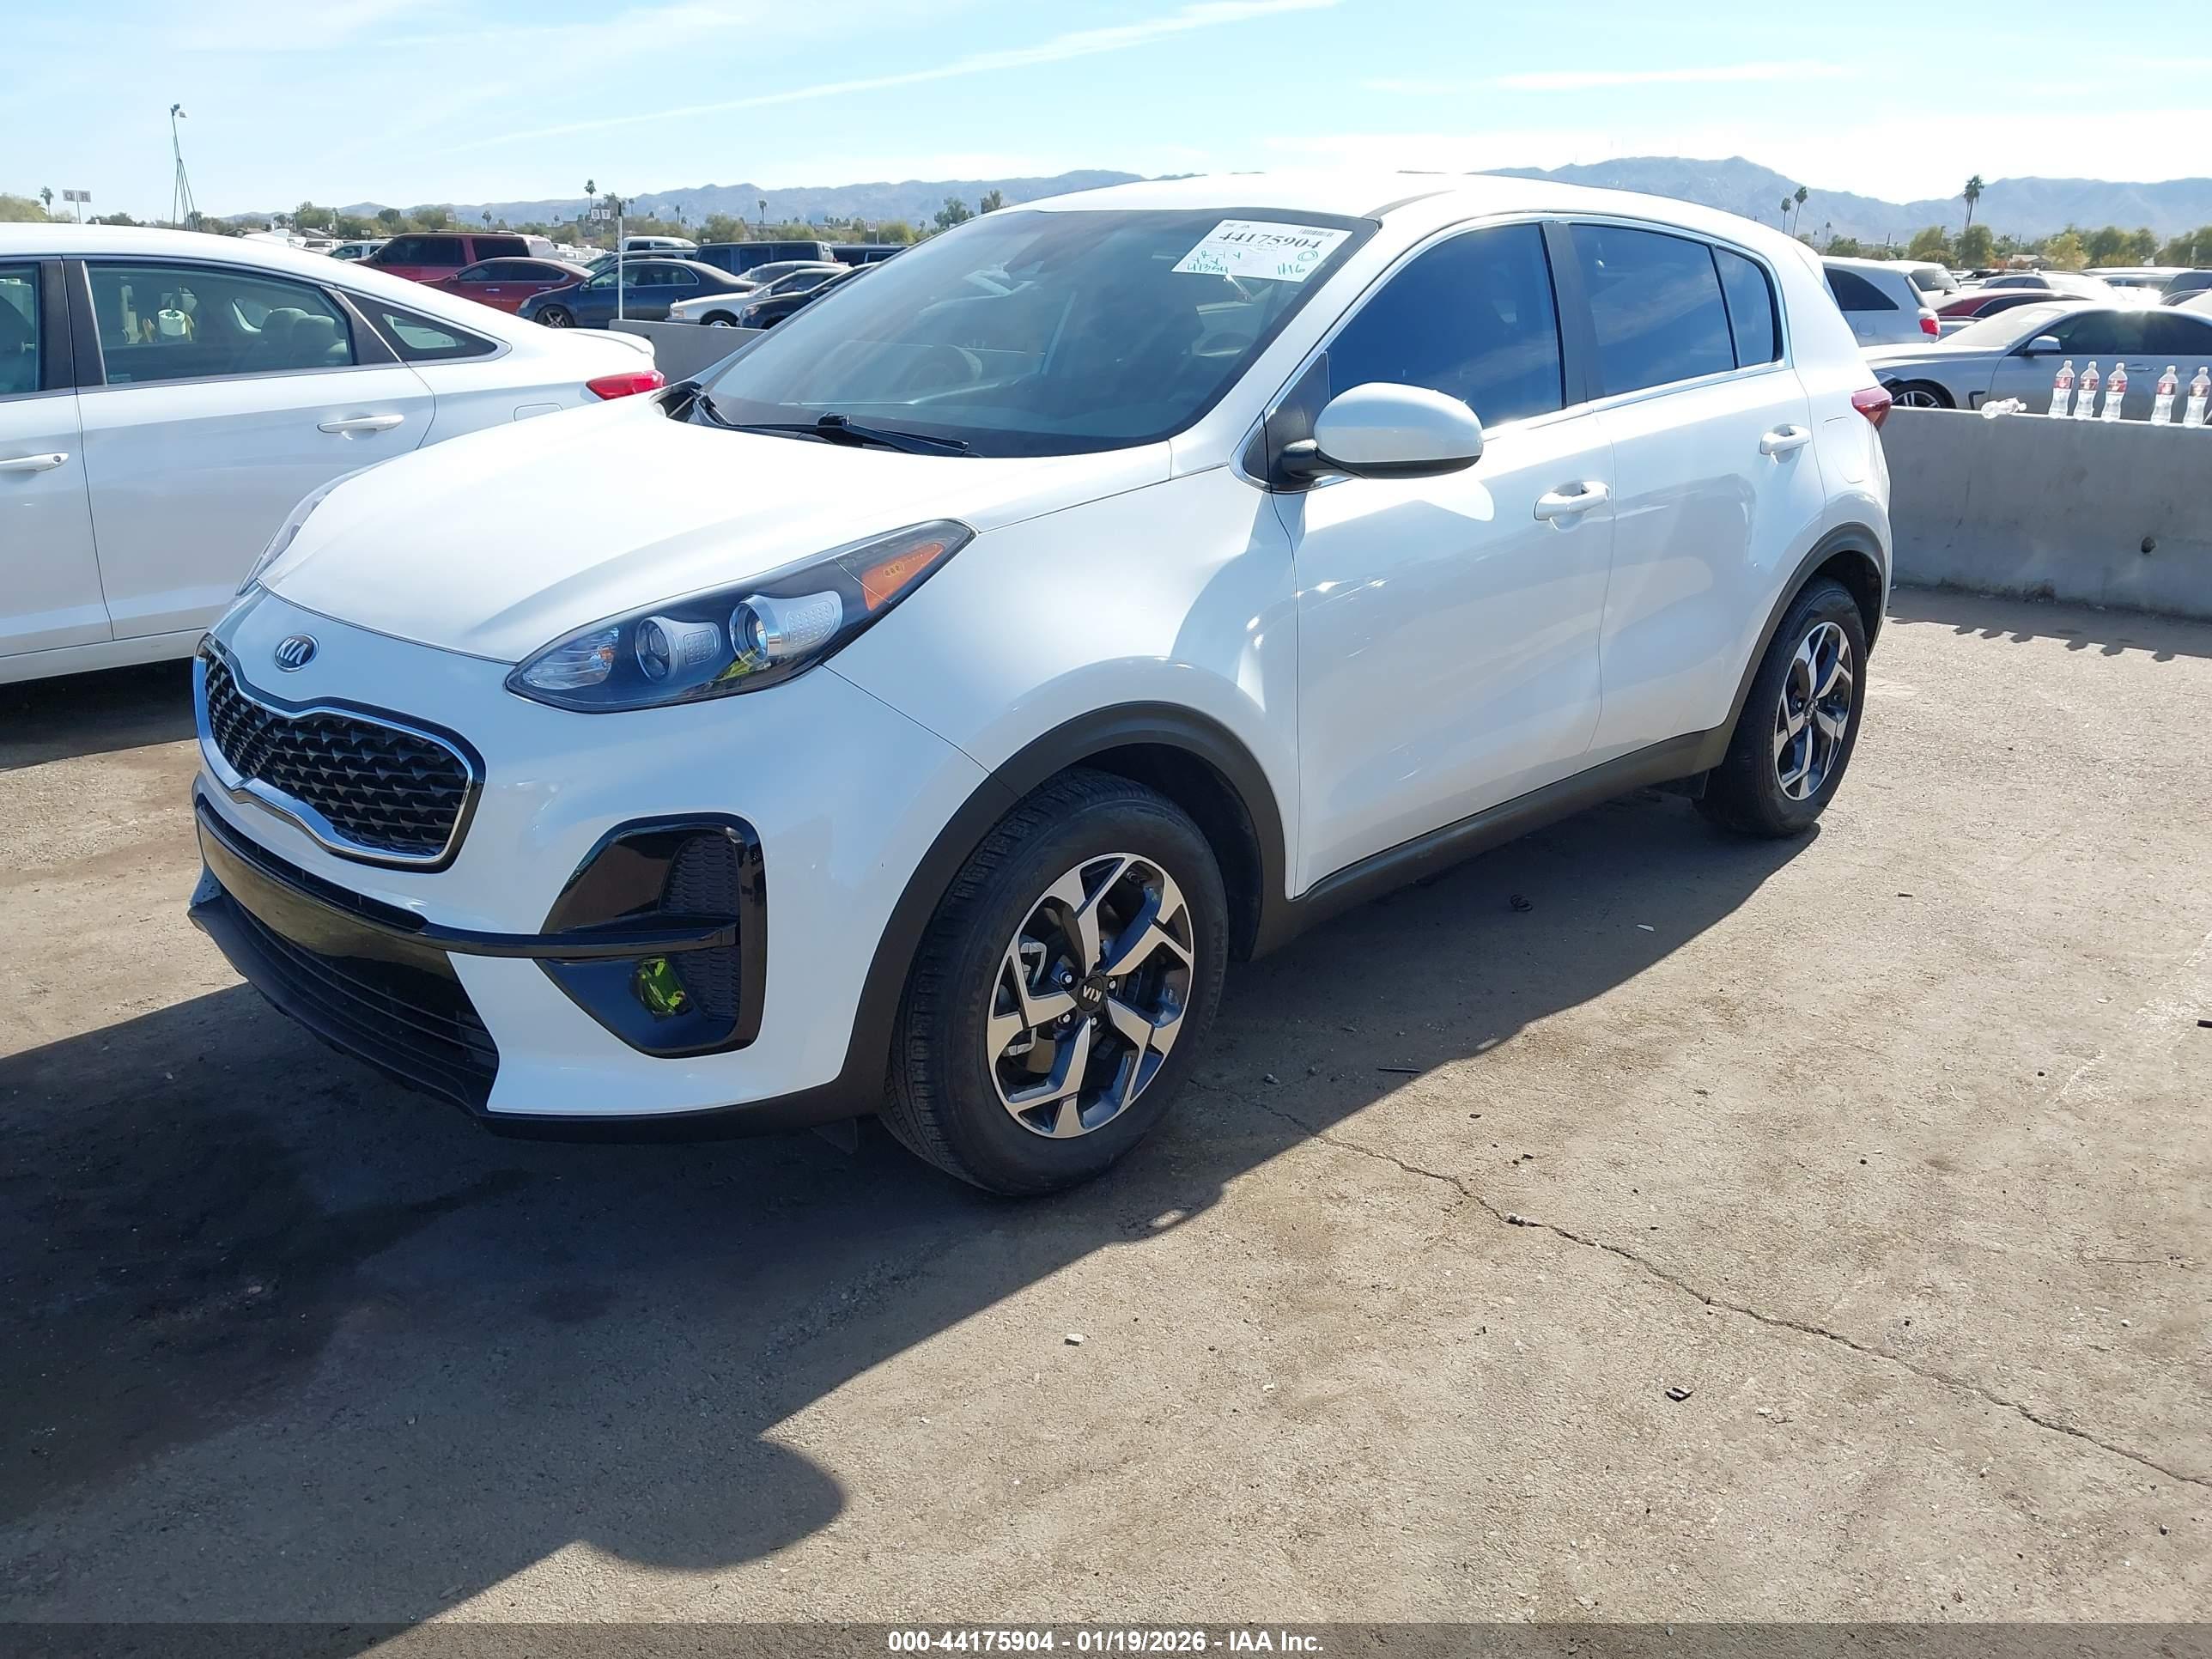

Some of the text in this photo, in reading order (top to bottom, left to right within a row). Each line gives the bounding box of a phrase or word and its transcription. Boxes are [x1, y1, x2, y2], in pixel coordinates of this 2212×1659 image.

[1218, 231, 1322, 249] 44175904
[276, 637, 308, 665] KIA
[1083, 985, 1102, 1003] KIA
